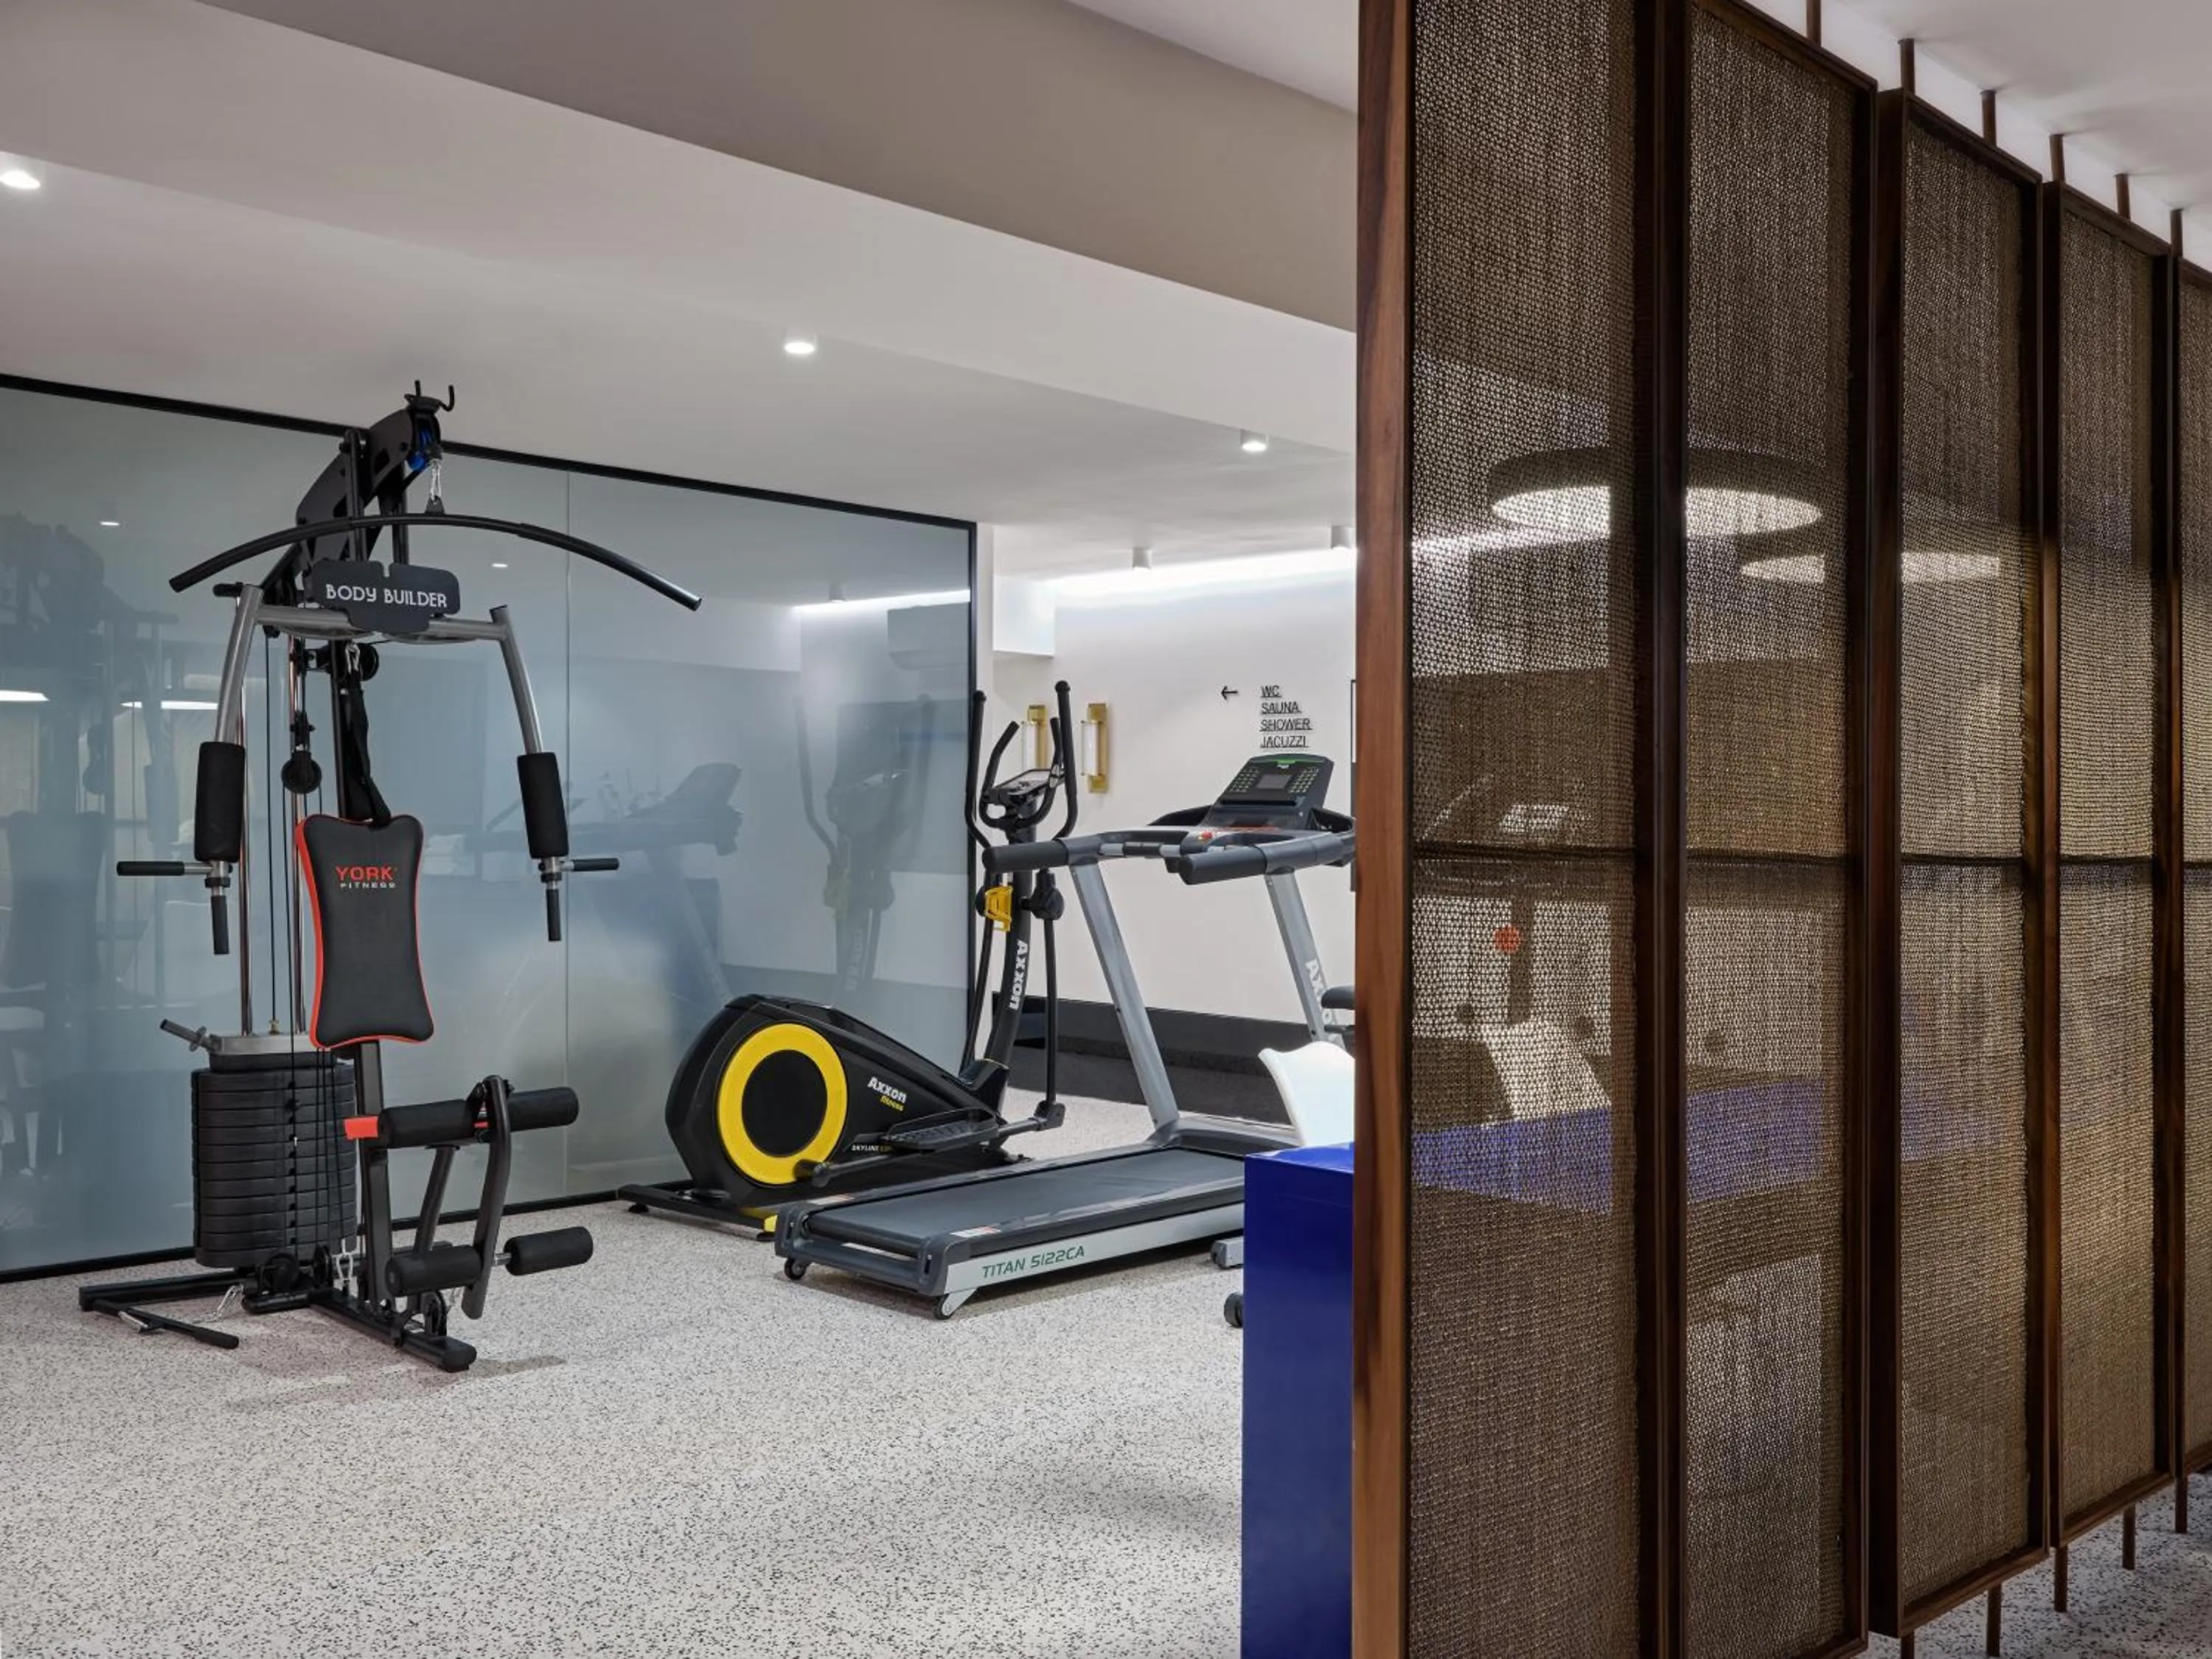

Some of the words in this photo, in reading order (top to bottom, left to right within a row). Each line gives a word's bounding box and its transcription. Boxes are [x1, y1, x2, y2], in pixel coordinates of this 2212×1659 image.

[325, 583, 378, 602] BODY
[383, 588, 448, 608] BUILDER
[1261, 685, 1281, 698] WC
[1261, 701, 1301, 714] SAUNA
[1259, 717, 1312, 731] SHOWER
[1260, 735, 1308, 748] JACUZZI
[335, 866, 393, 881] YORK
[981, 1257, 1026, 1278] TITAN
[1030, 1245, 1085, 1268] 5122CA
